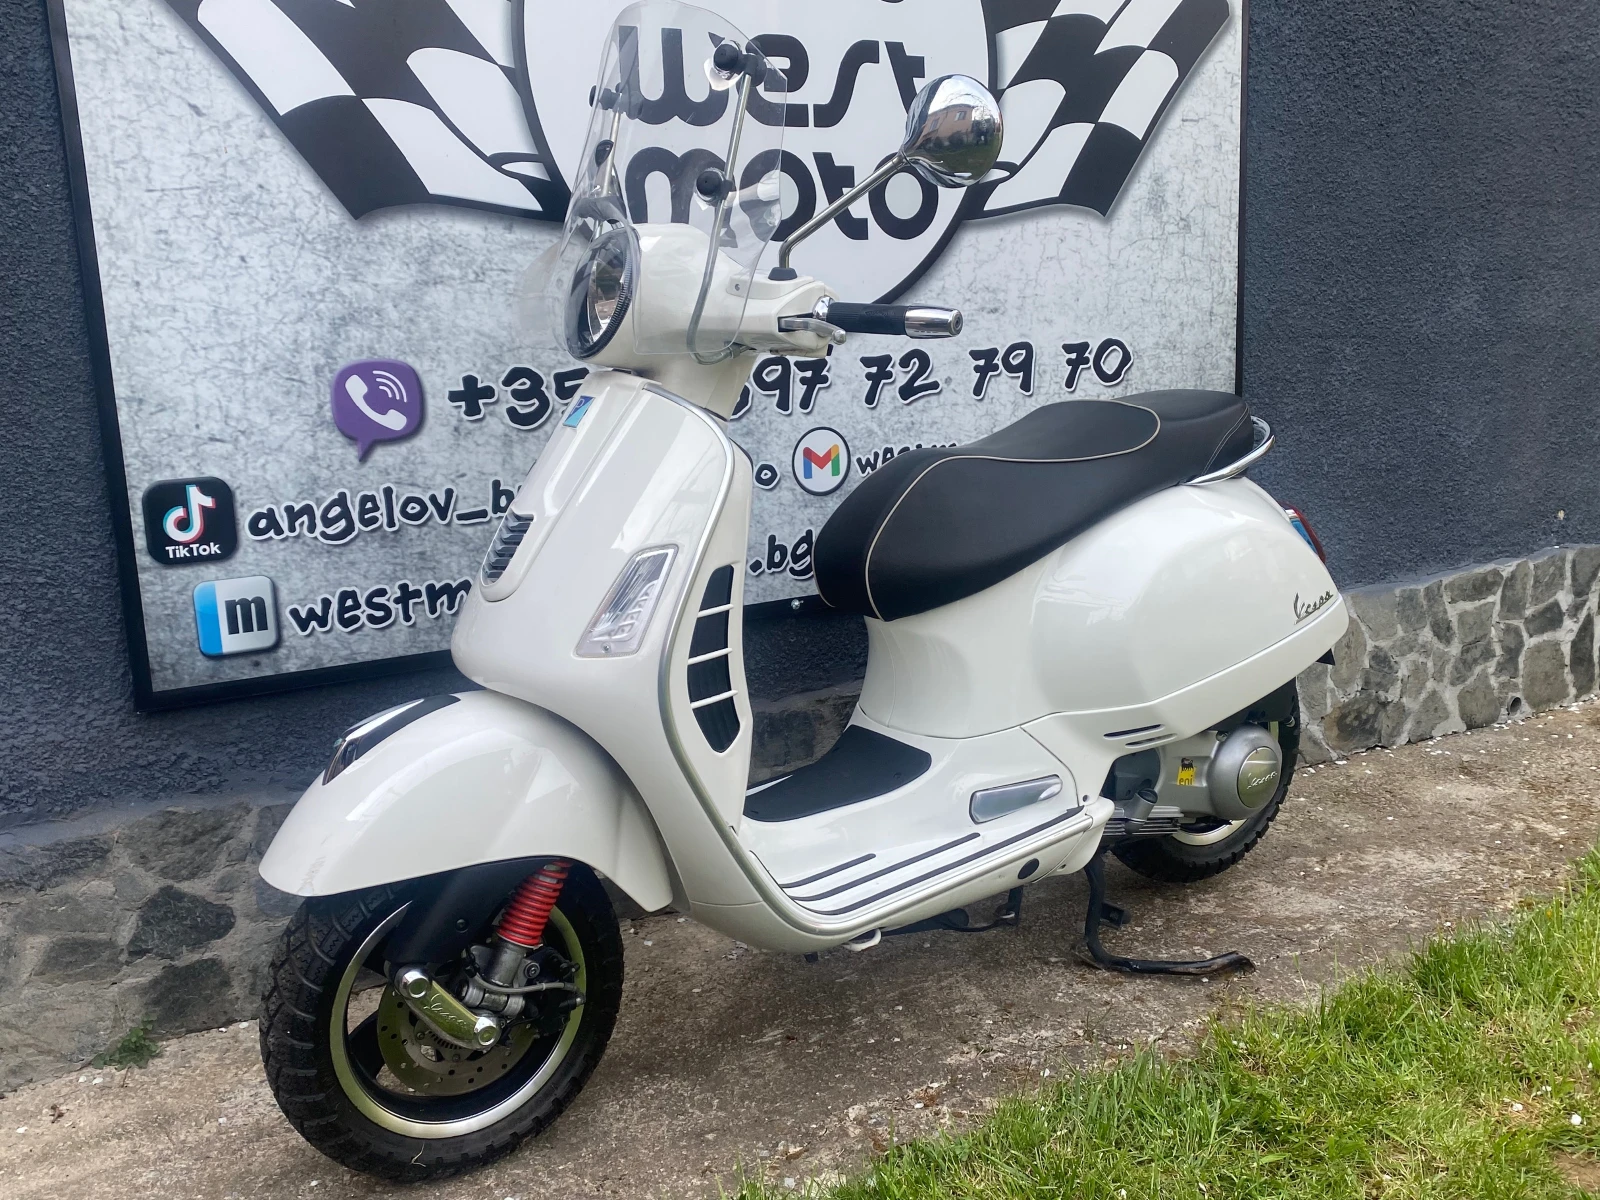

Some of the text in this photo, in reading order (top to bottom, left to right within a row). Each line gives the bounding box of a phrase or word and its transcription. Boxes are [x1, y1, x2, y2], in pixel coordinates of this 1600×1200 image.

[625, 147, 939, 240] moto
[731, 356, 830, 415] 97
[860, 349, 940, 406] 72
[969, 341, 1034, 397] 79
[1062, 338, 1132, 390] 70
[248, 479, 522, 544] angelov_b
[165, 542, 221, 559] TikTok
[224, 596, 269, 635] m
[1293, 590, 1334, 625] Vespa
[1179, 775, 1194, 786] eni
